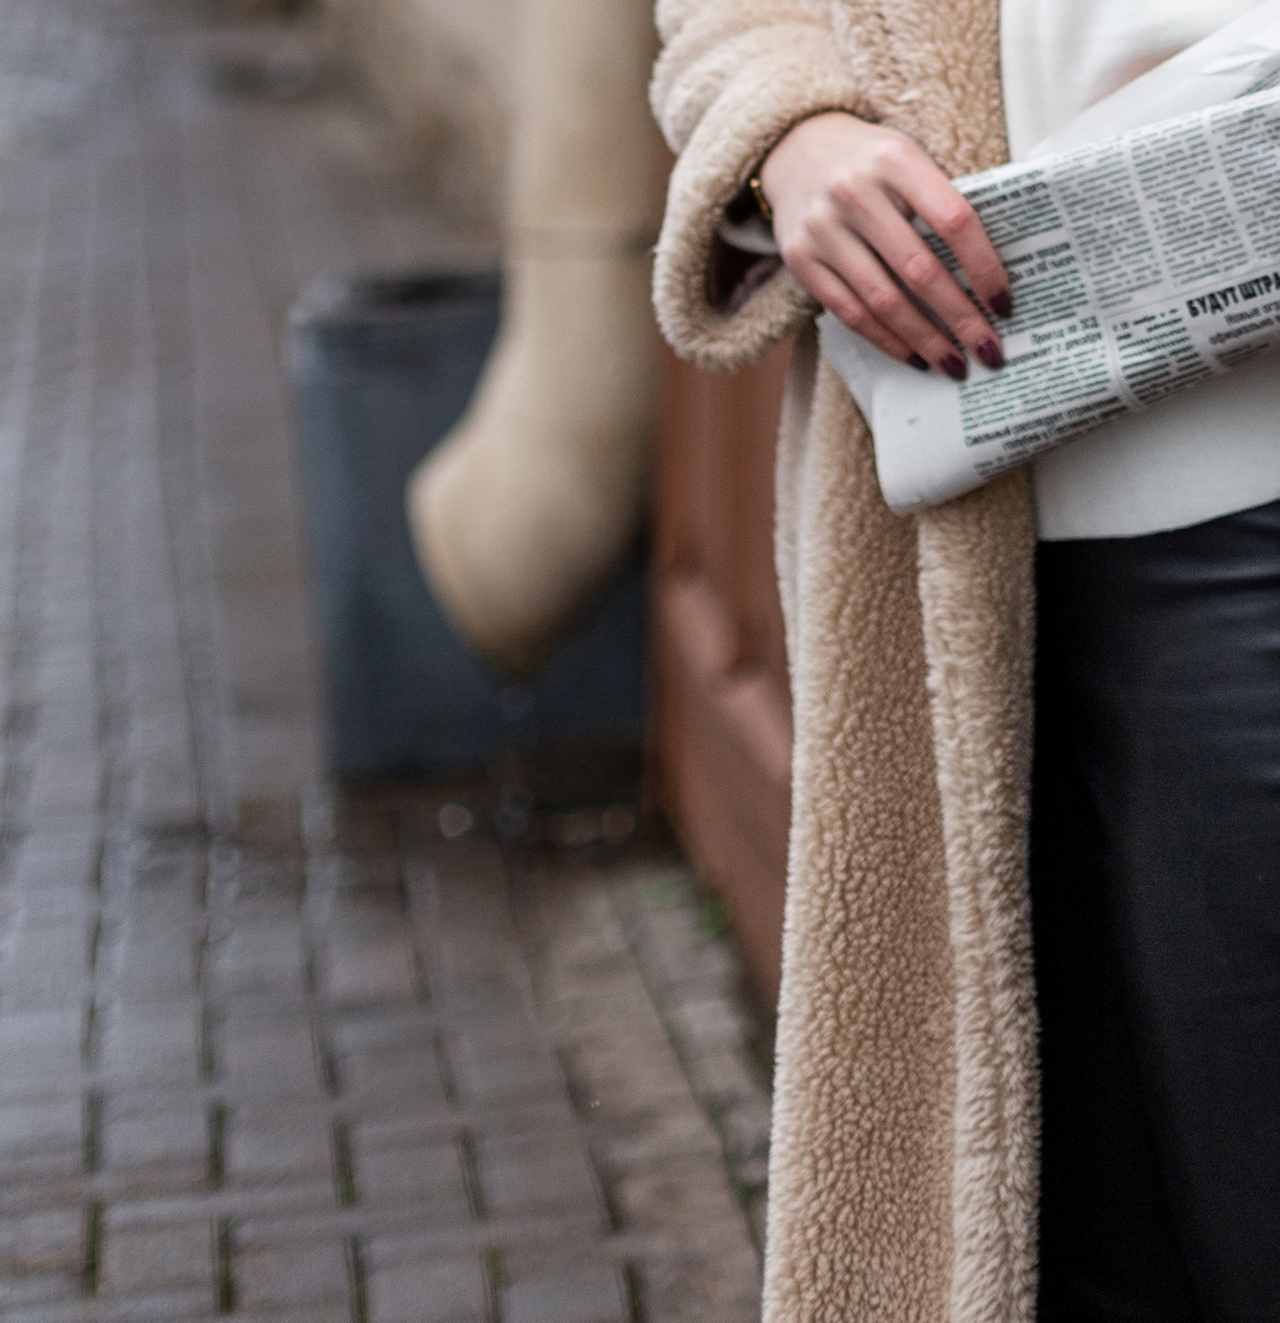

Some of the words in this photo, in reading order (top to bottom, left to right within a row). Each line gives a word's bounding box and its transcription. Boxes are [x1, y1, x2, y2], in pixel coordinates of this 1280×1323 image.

[1187, 286, 1239, 318] БУДУТ
[1209, 317, 1275, 345] официально
[1224, 308, 1261, 326] Новые
